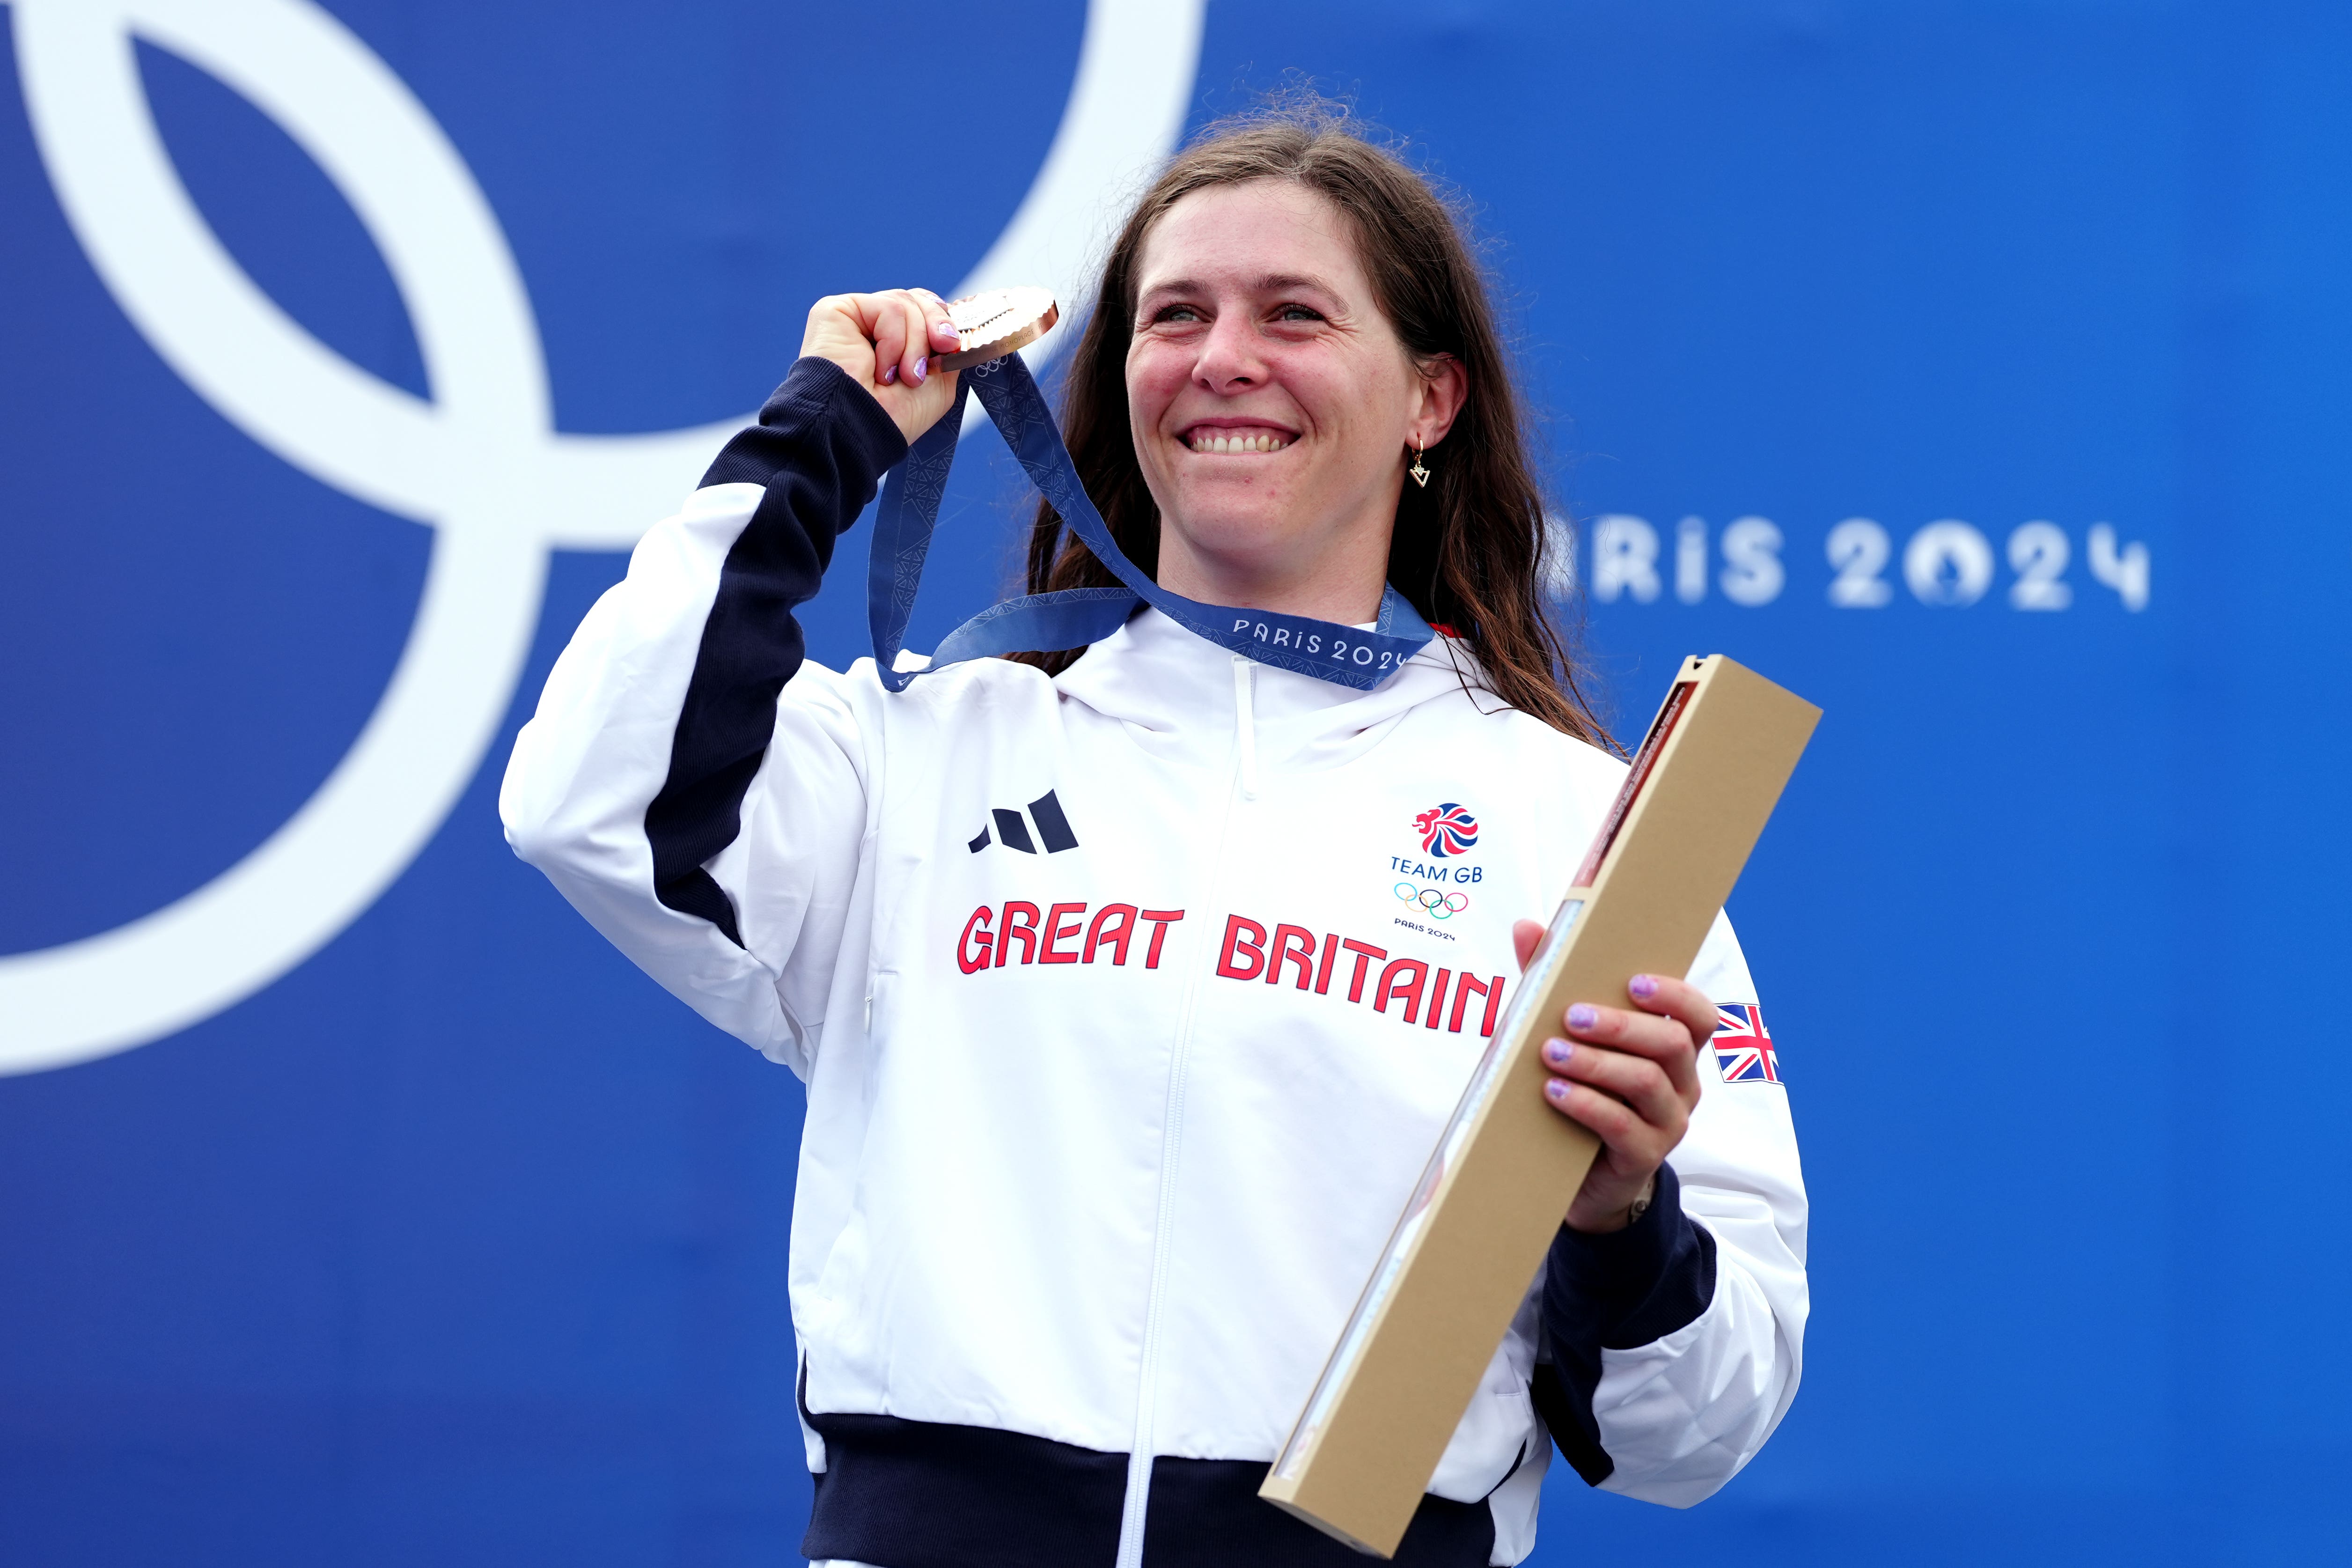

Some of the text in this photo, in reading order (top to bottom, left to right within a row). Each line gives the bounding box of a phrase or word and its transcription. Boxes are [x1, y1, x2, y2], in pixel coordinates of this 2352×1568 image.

[1826, 517, 2151, 612] 2024
[1331, 640, 1407, 670] 2024
[1391, 856, 1483, 883] TEAM GB
[1427, 928, 1455, 942] 2024
[956, 900, 1185, 975] GREAT
[1215, 913, 1506, 1038] BRITAIN
